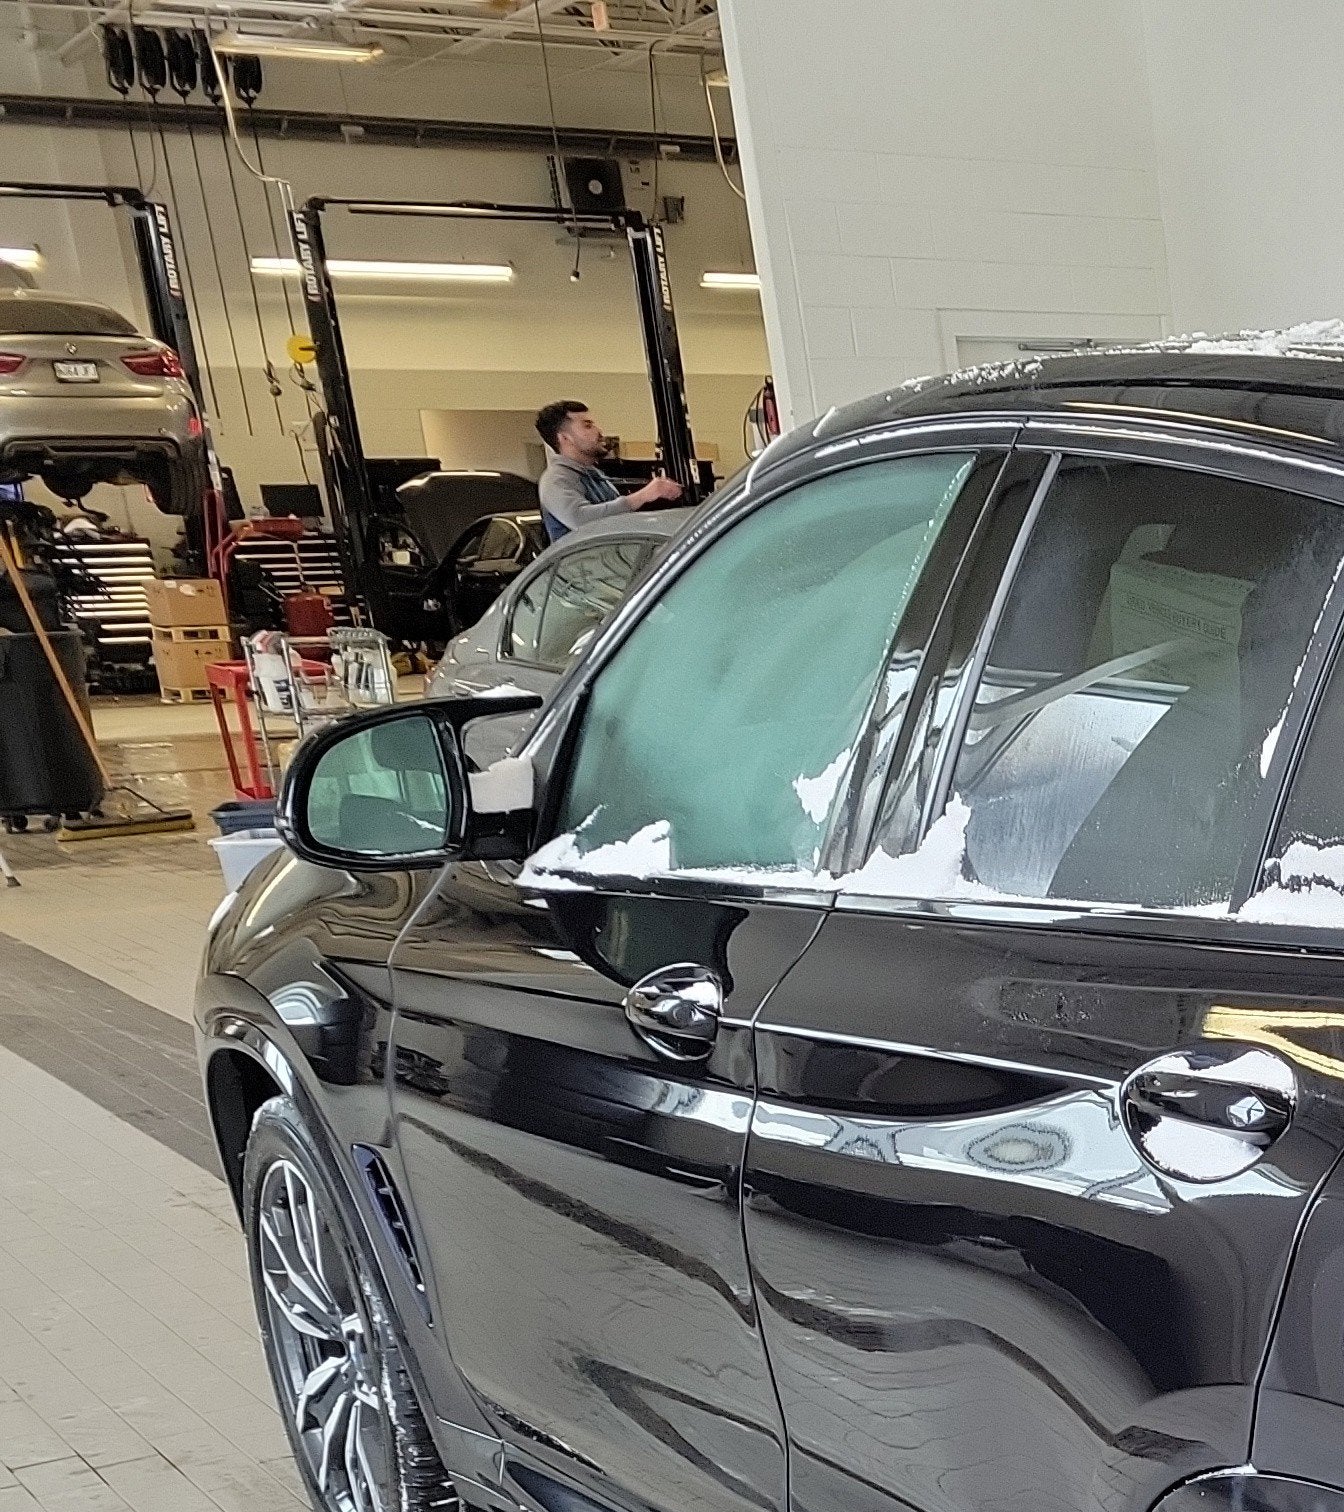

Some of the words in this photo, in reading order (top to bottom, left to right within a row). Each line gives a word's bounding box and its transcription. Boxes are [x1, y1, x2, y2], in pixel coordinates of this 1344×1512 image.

[154, 203, 169, 233] LIFT
[292, 211, 309, 241] LIFT
[653, 226, 664, 253] LIFT
[160, 234, 180, 290] ROTARY
[298, 241, 319, 295] ROTARY
[657, 254, 671, 304] ROTARY
